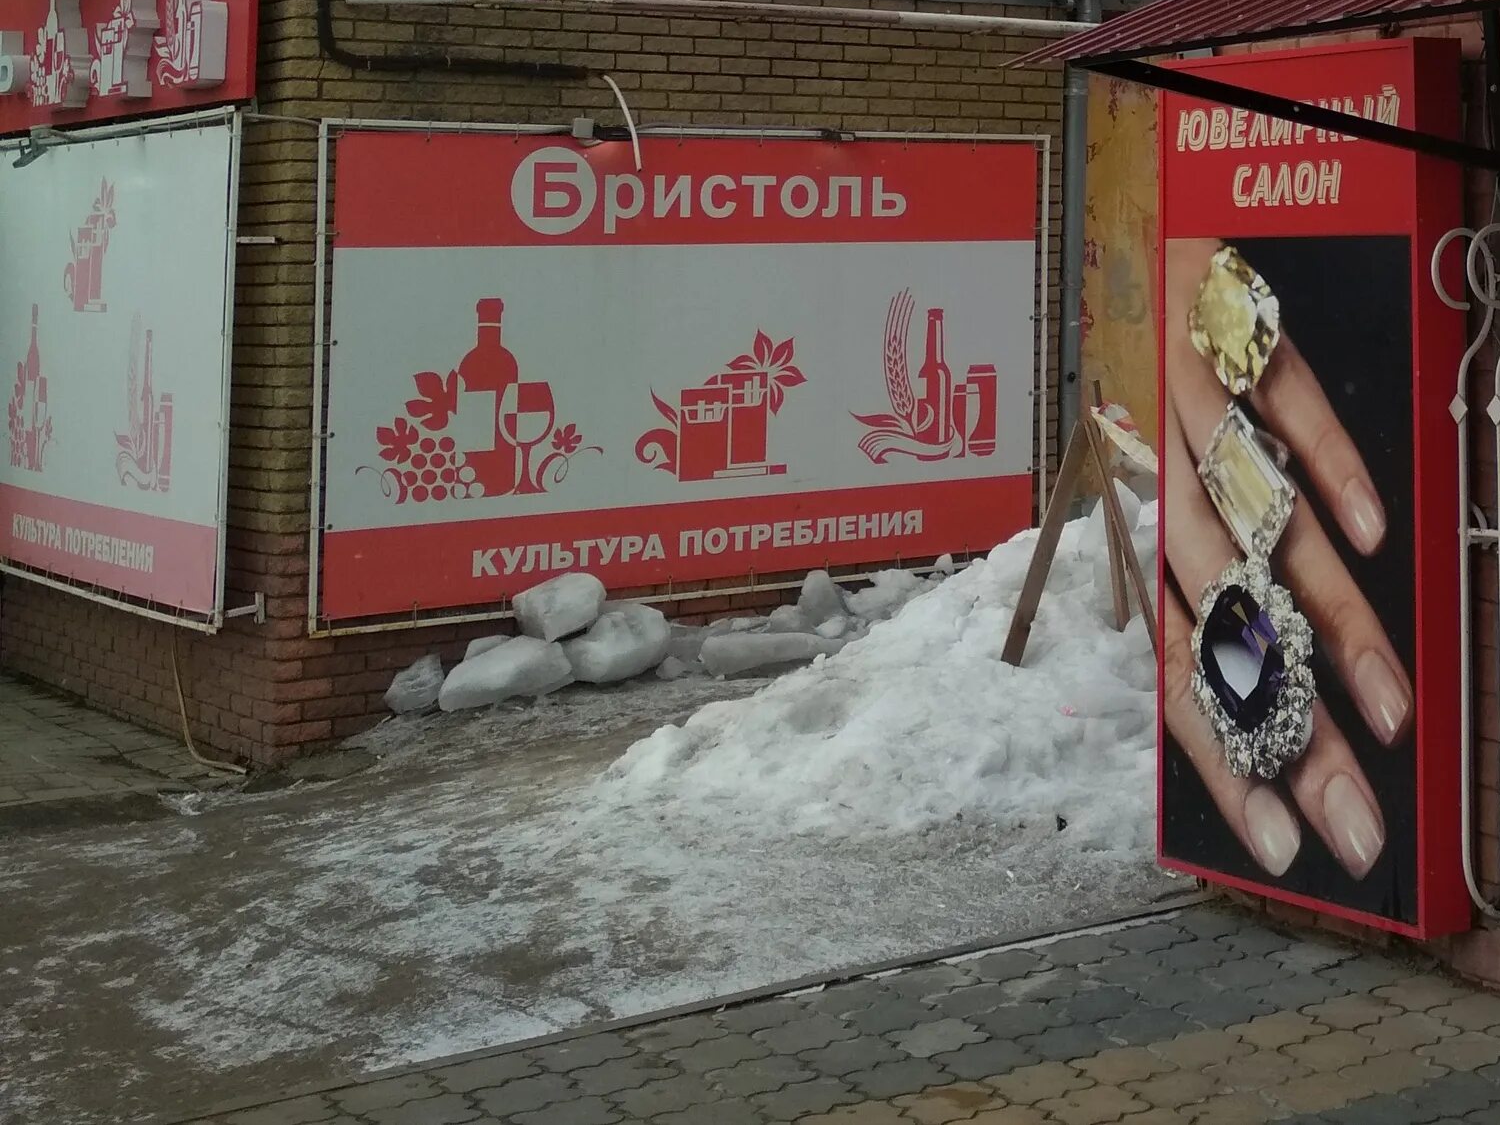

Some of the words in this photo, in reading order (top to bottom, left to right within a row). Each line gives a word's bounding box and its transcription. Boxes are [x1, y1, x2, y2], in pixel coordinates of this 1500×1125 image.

[530, 159, 908, 235] Бристоль
[1232, 159, 1342, 209] САЛОН
[12, 513, 62, 551] КУЛЬТУРА
[65, 527, 154, 573] ПОТРЕБЛЕНИЯ
[471, 532, 665, 579] КУЛЬТУРА
[679, 509, 924, 559] ПОТРЕБЛЕНИЯ
